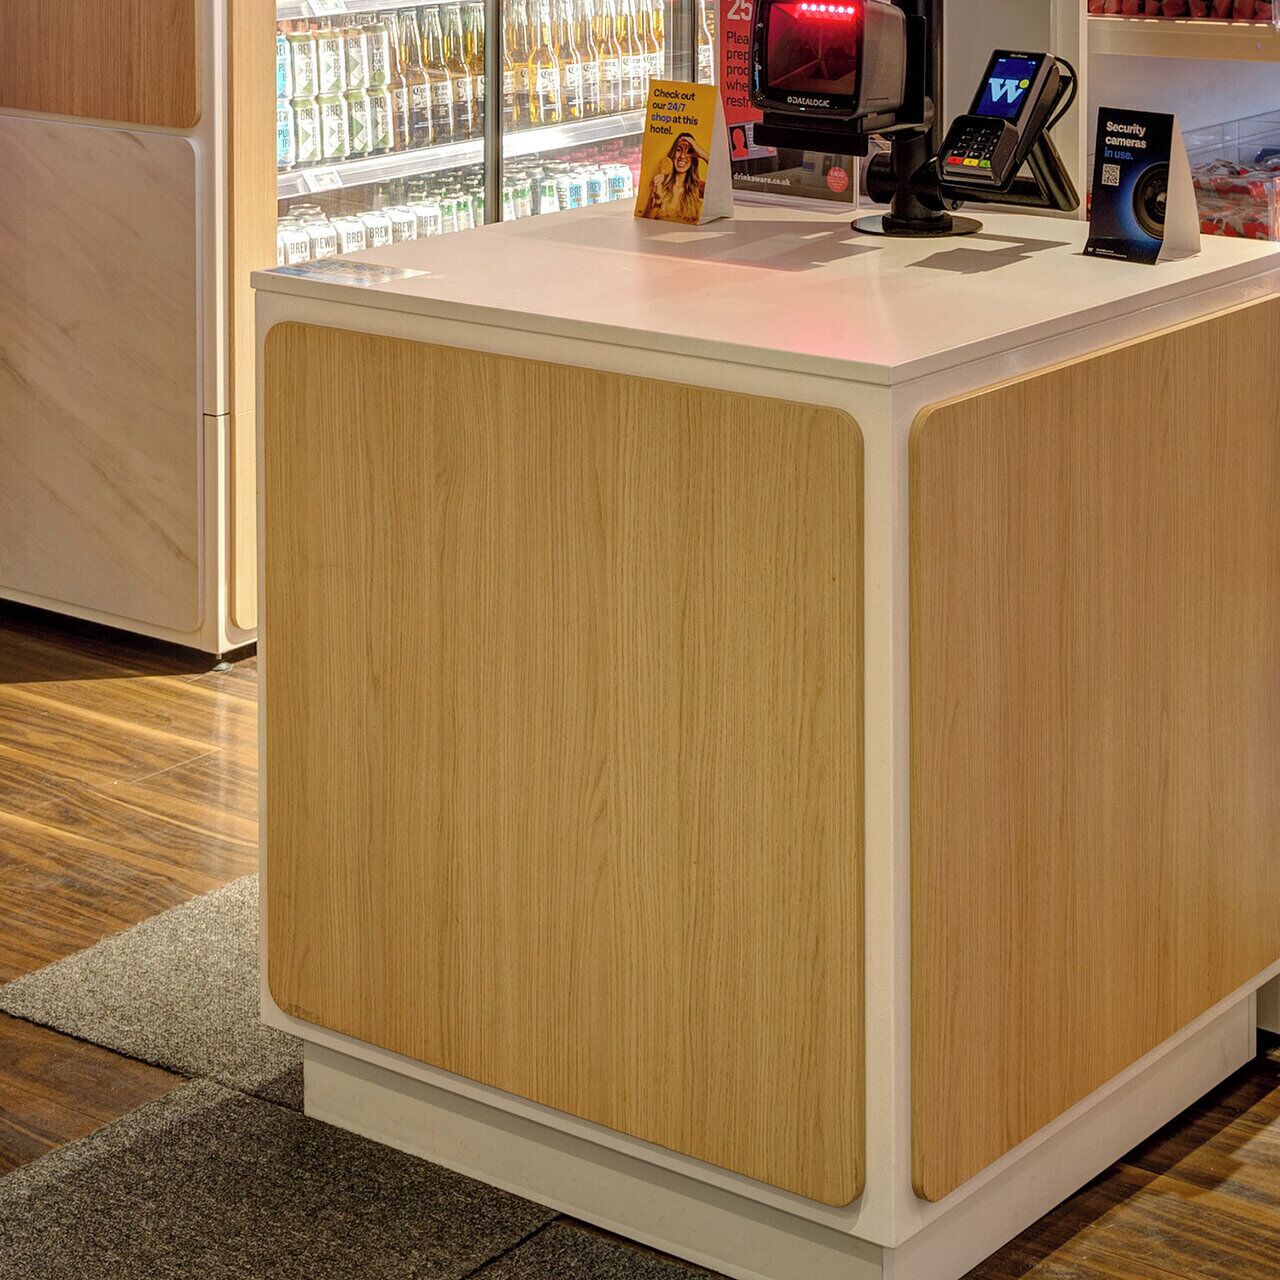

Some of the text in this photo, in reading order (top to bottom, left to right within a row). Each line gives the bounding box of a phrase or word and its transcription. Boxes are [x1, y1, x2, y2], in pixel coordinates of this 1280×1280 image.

[726, 31, 748, 45] Plea
[726, 48, 749, 62] prep
[726, 79, 748, 93] whe
[988, 77, 1024, 104] W
[653, 88, 696, 101] Check out
[666, 102, 686, 112] 24/7
[726, 96, 752, 108] restr
[792, 96, 830, 107] DATALOGIC
[651, 113, 698, 125] shop at this
[650, 124, 673, 135] hotel.
[1106, 121, 1146, 137] Security
[1105, 136, 1147, 149] cameras
[1104, 147, 1134, 161] in use.
[733, 173, 791, 186] drinkaware.co.uk
